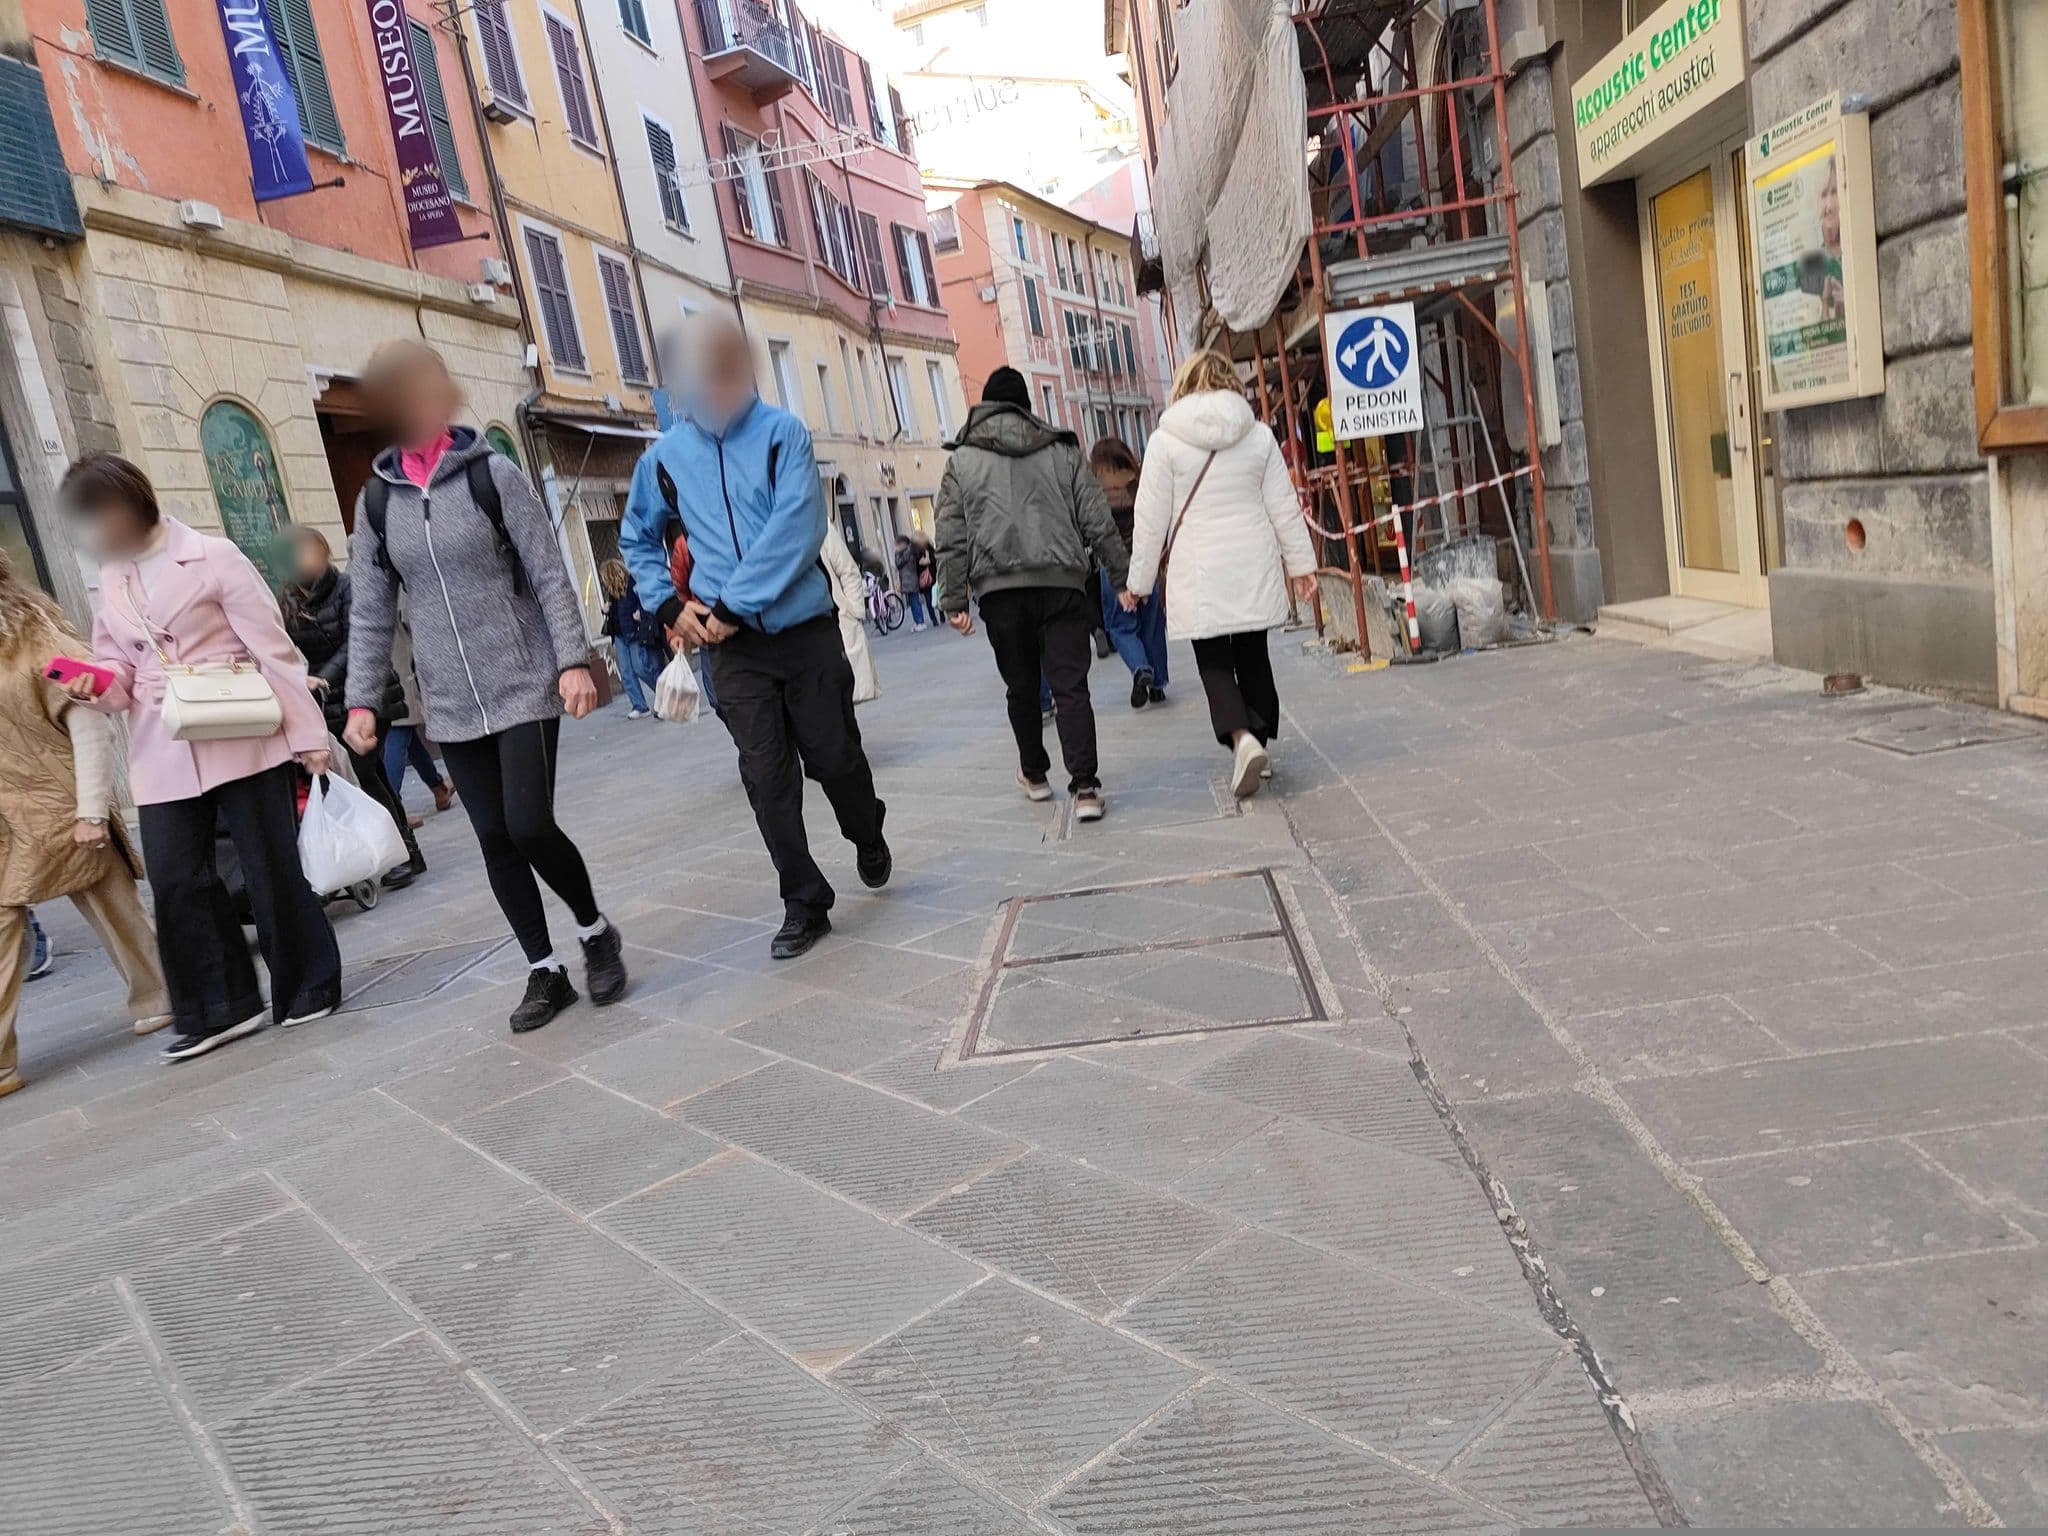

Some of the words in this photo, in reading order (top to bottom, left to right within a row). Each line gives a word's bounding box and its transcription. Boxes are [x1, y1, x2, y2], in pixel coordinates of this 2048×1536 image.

[372, 0, 425, 141] MUSEO
[1576, 51, 1646, 129] Acoustic
[1650, 0, 1721, 69] Center
[1590, 93, 1655, 161] apparecchi
[1658, 45, 1715, 109] acustici
[1771, 115, 1804, 140] Acoustic
[1806, 99, 1833, 121] Center
[412, 183, 438, 197] MUSEO
[407, 196, 450, 213] DIOCESANO
[1679, 280, 1696, 299] TEST
[1671, 295, 1708, 320] GRATUITO
[1671, 314, 1712, 338] DELL'UDITO
[1346, 389, 1407, 410] PEDONI
[1340, 418, 1348, 432] A
[1353, 408, 1417, 431] SINISTRA
